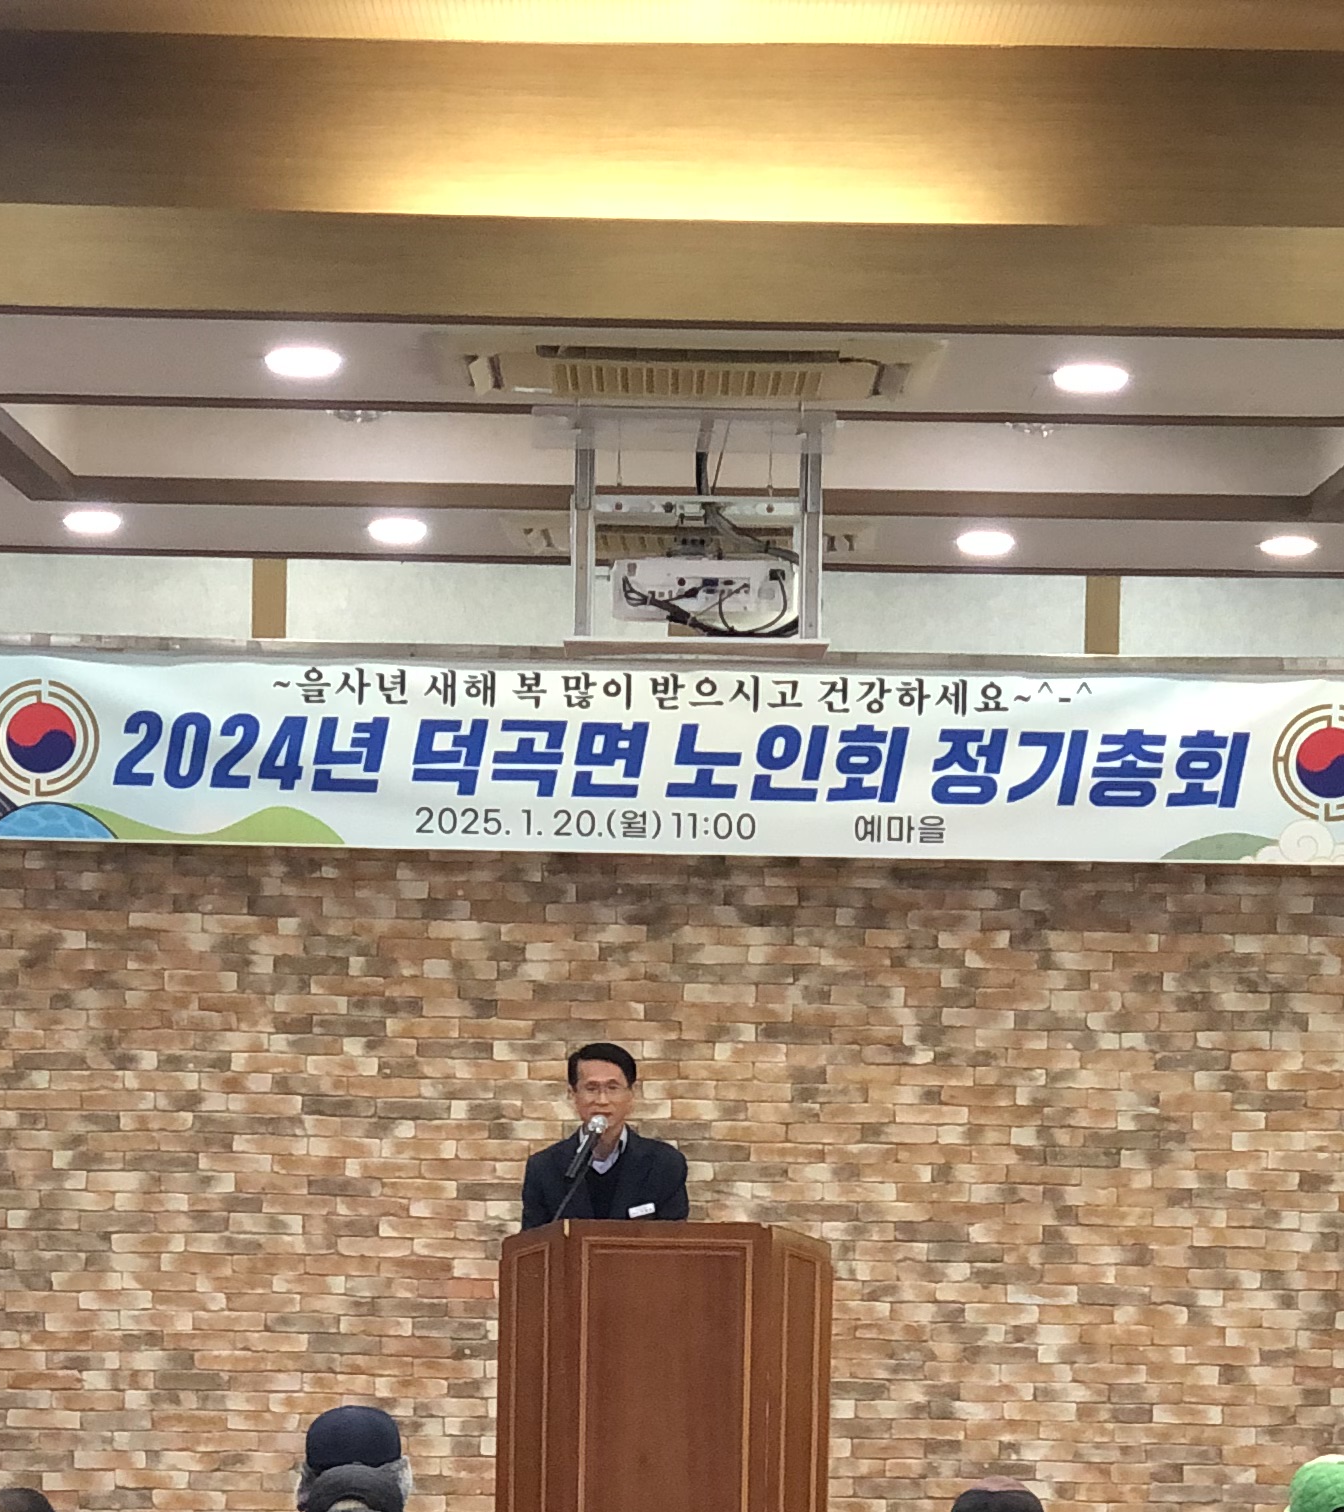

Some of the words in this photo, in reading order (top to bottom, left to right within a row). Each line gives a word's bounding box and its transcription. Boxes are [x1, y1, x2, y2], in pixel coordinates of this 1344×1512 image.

[424, 669, 497, 708] 새해
[512, 672, 547, 709] 복
[561, 672, 634, 710] 많이
[648, 673, 804, 715] 받으시고
[113, 710, 390, 793] 2024년
[412, 718, 649, 799] 덕곡면
[666, 724, 909, 804] 노인회
[931, 728, 1250, 808] 정기총회
[854, 814, 947, 845] 예마을
